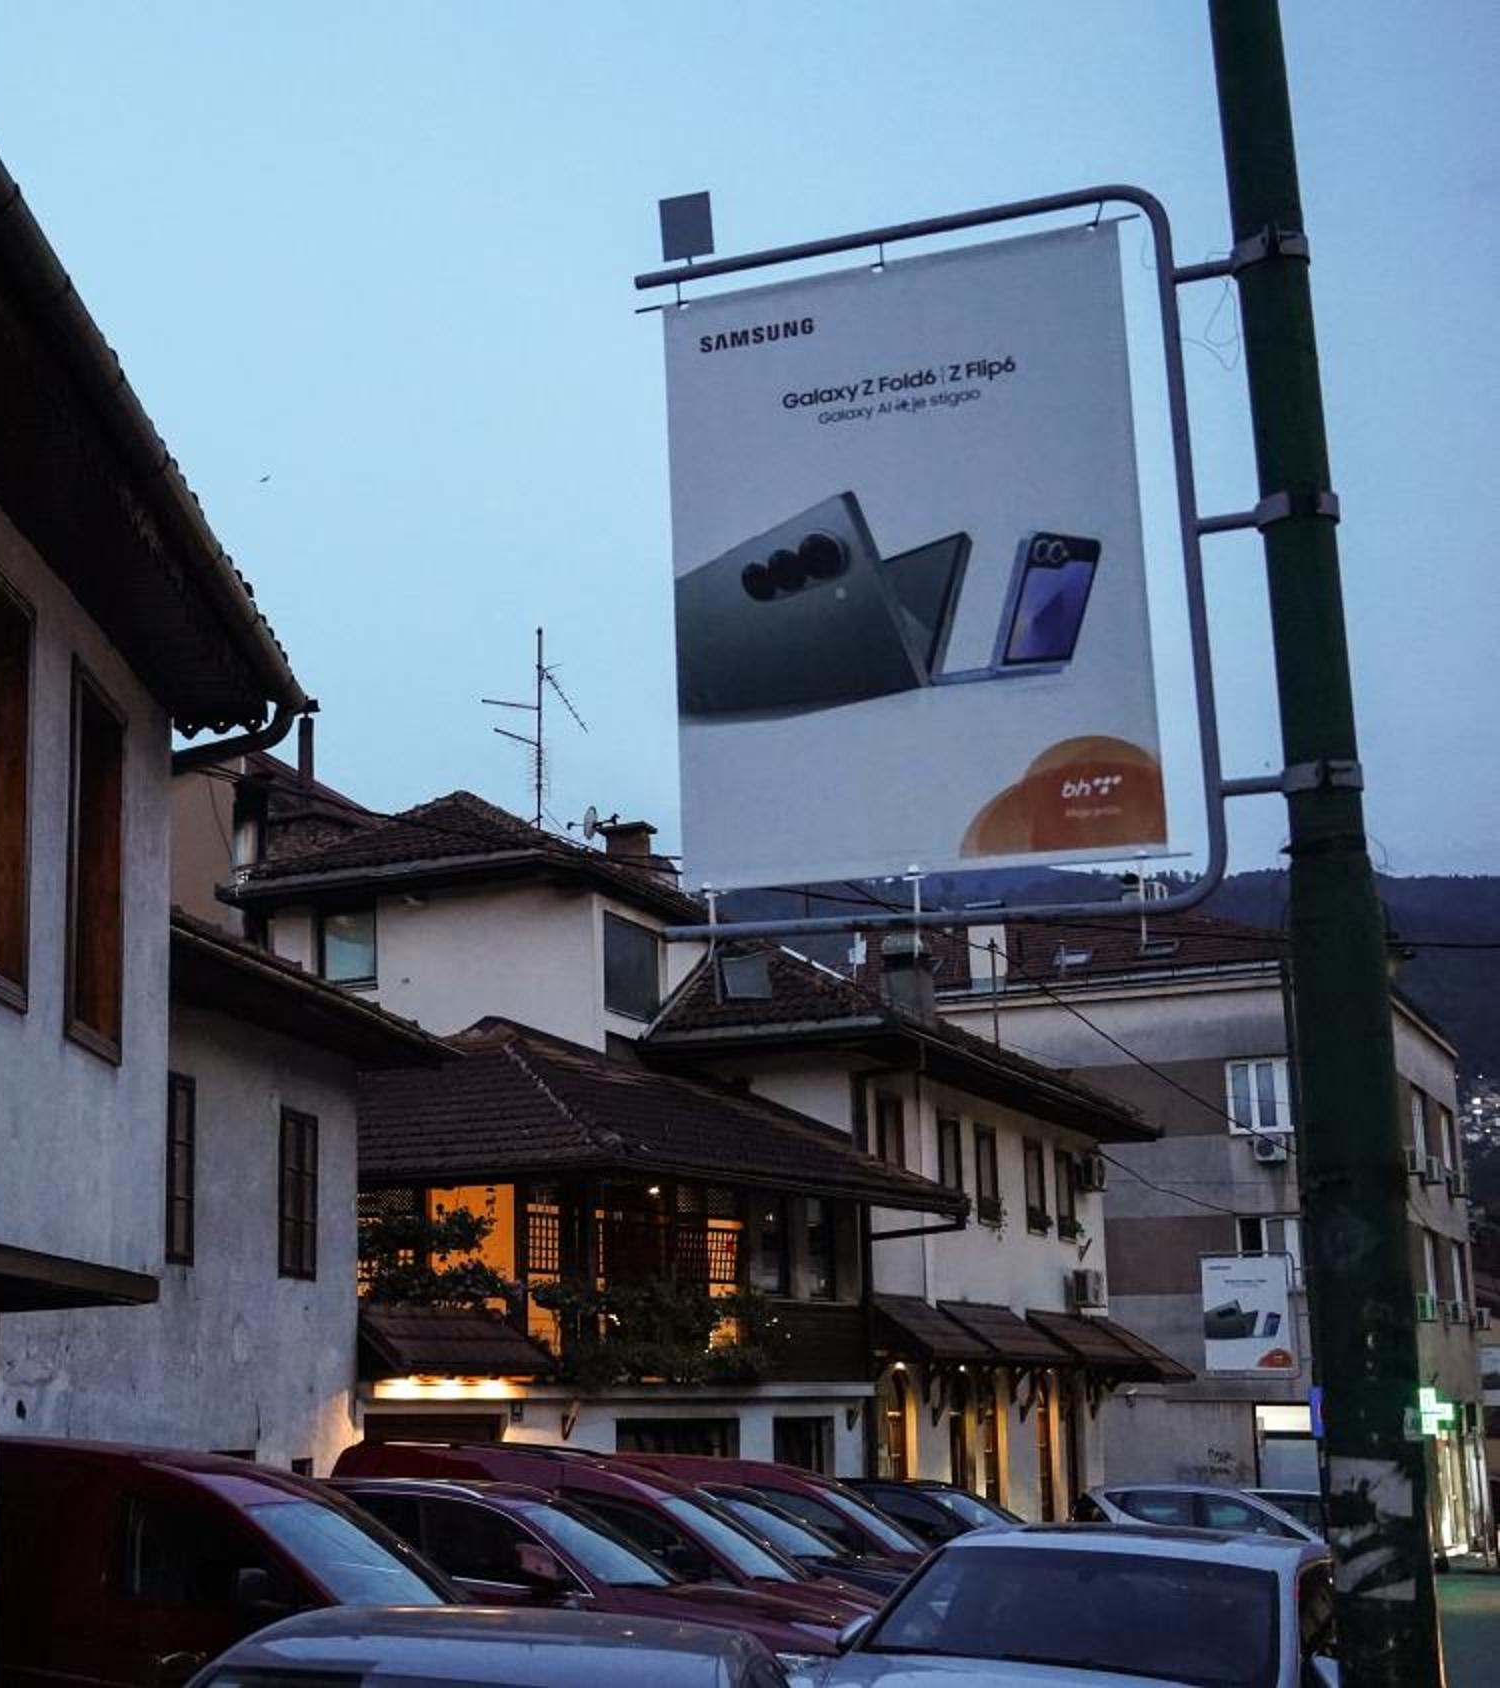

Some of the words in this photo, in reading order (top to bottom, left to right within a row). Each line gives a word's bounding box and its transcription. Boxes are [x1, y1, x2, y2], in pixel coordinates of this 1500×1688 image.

[699, 317, 815, 353] SAMSUNG
[783, 380, 858, 410] Galaxy
[863, 379, 875, 397] Z
[879, 369, 936, 393] Fold6
[949, 365, 962, 382] Z
[966, 355, 1016, 381] Flip6
[818, 404, 873, 425] Galaxy
[929, 389, 981, 411] stigao
